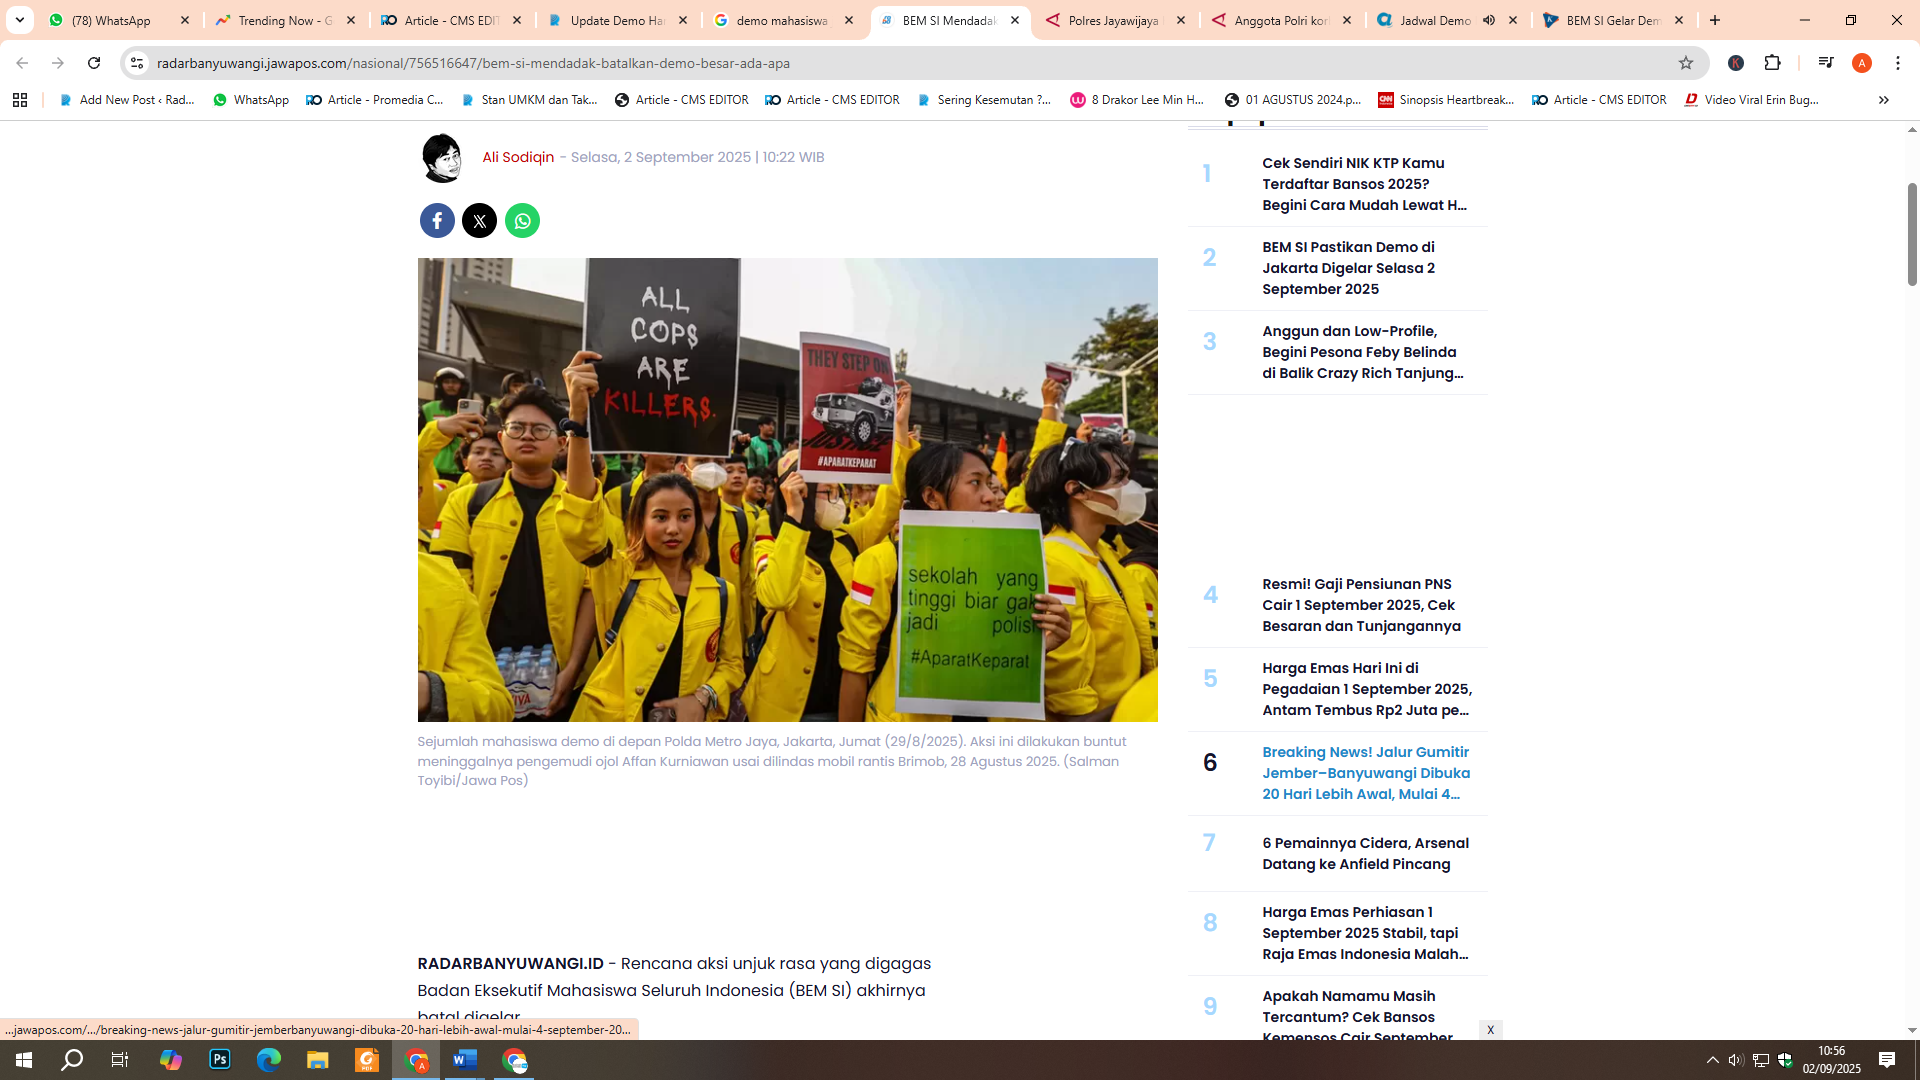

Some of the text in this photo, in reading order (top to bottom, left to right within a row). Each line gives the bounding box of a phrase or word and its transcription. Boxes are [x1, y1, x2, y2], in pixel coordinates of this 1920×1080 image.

[73, 16, 150, 28] (78) WhatsApp
[572, 16, 645, 28] Update Demo
[737, 16, 827, 25] demo mahasiswa
[904, 16, 999, 25] BEM SI Mendadak
[1070, 16, 1158, 28] Polres Jayawijaya
[1401, 16, 1473, 25] Jadwal Demo
[234, 95, 289, 107] WhatsApp
[482, 95, 505, 104] Stan
[509, 95, 545, 104] UMKM
[548, 95, 568, 104] dan
[938, 95, 971, 107] Sering
[975, 95, 1033, 104] Kesemutan
[1092, 95, 1099, 104] 8
[1102, 95, 1138, 104] Drakor
[1142, 95, 1159, 104] Lee
[1163, 95, 1183, 104] Min
[1246, 95, 1257, 104] 01
[1262, 95, 1313, 104] AGUSTUS
[1400, 95, 1444, 107] Sinopsis
[1705, 95, 1736, 104] Video
[1739, 95, 1762, 104] Viral
[1766, 95, 1786, 104] Erin
[482, 151, 824, 166] Ali Sodiqin Selasa, 2 September 2025 10:22 WIB
[1263, 157, 1444, 168] Cek Sendiri NIK KTP Kamu
[1203, 164, 1210, 182] 1
[1263, 178, 1430, 189] Terdaftar Bansos 2025?
[1263, 199, 1307, 214] Begini
[1310, 200, 1345, 210] Cara
[1349, 199, 1398, 210] Mudah
[1403, 200, 1444, 210] Lewat
[1263, 241, 1435, 252] BEM SI Pastikan Demo di
[1204, 248, 1216, 266] 2
[1263, 262, 1435, 277] Jakarta Digelar Selasa 2
[1263, 283, 1379, 298] September 2025
[642, 286, 690, 313] ALL
[631, 317, 698, 349] COPS
[1204, 332, 1216, 350] 3
[807, 349, 889, 375] THEY STEP ON
[637, 355, 690, 390] ARE
[604, 387, 717, 428] KILLERS.
[817, 456, 877, 469] #APARATKEPARAT
[908, 566, 1038, 591] sekolah yang
[908, 589, 956, 612] tinggi
[965, 592, 998, 609] biar
[906, 612, 938, 634] jadi
[911, 649, 1029, 671] #AparatKeparat
[418, 734, 1127, 750] Sejumlah mahasiswa demo di depan Polda Metro Jaya, Jakarta, Jumat (29/8/2025). Aksi ini dilakukan buntut
[1263, 746, 1469, 761] Breaking News! Jalur Gumitir
[1204, 753, 1217, 771] 6
[1421, 767, 1470, 778] Dibuka
[418, 773, 528, 789] Toyibi/Jawa Pos)
[1263, 788, 1279, 799] 20
[1284, 788, 1312, 799] Hari
[1316, 788, 1353, 799] Lebih
[1357, 788, 1395, 801] Awal,
[1399, 788, 1438, 799] Mulai
[1203, 833, 1215, 851] 7
[1263, 837, 1469, 852] 6 Pemainnya Cidera, Arsenal
[1263, 858, 1450, 873] Datang ke Anfield Pincang
[1204, 913, 1217, 932] 8
[418, 957, 931, 974] RADARBANYUWANGI.ID Rencana aksi unjuk rasa yang digagas
[418, 981, 925, 1000] Badan Eksekutif Mahasiswa Seluruh Indonesia (BEM SI) akhirnya
[1819, 1046, 1845, 1055] 10:56
[214, 1053, 227, 1065] Ps
[1803, 1064, 1861, 1074] 02/09/2025
